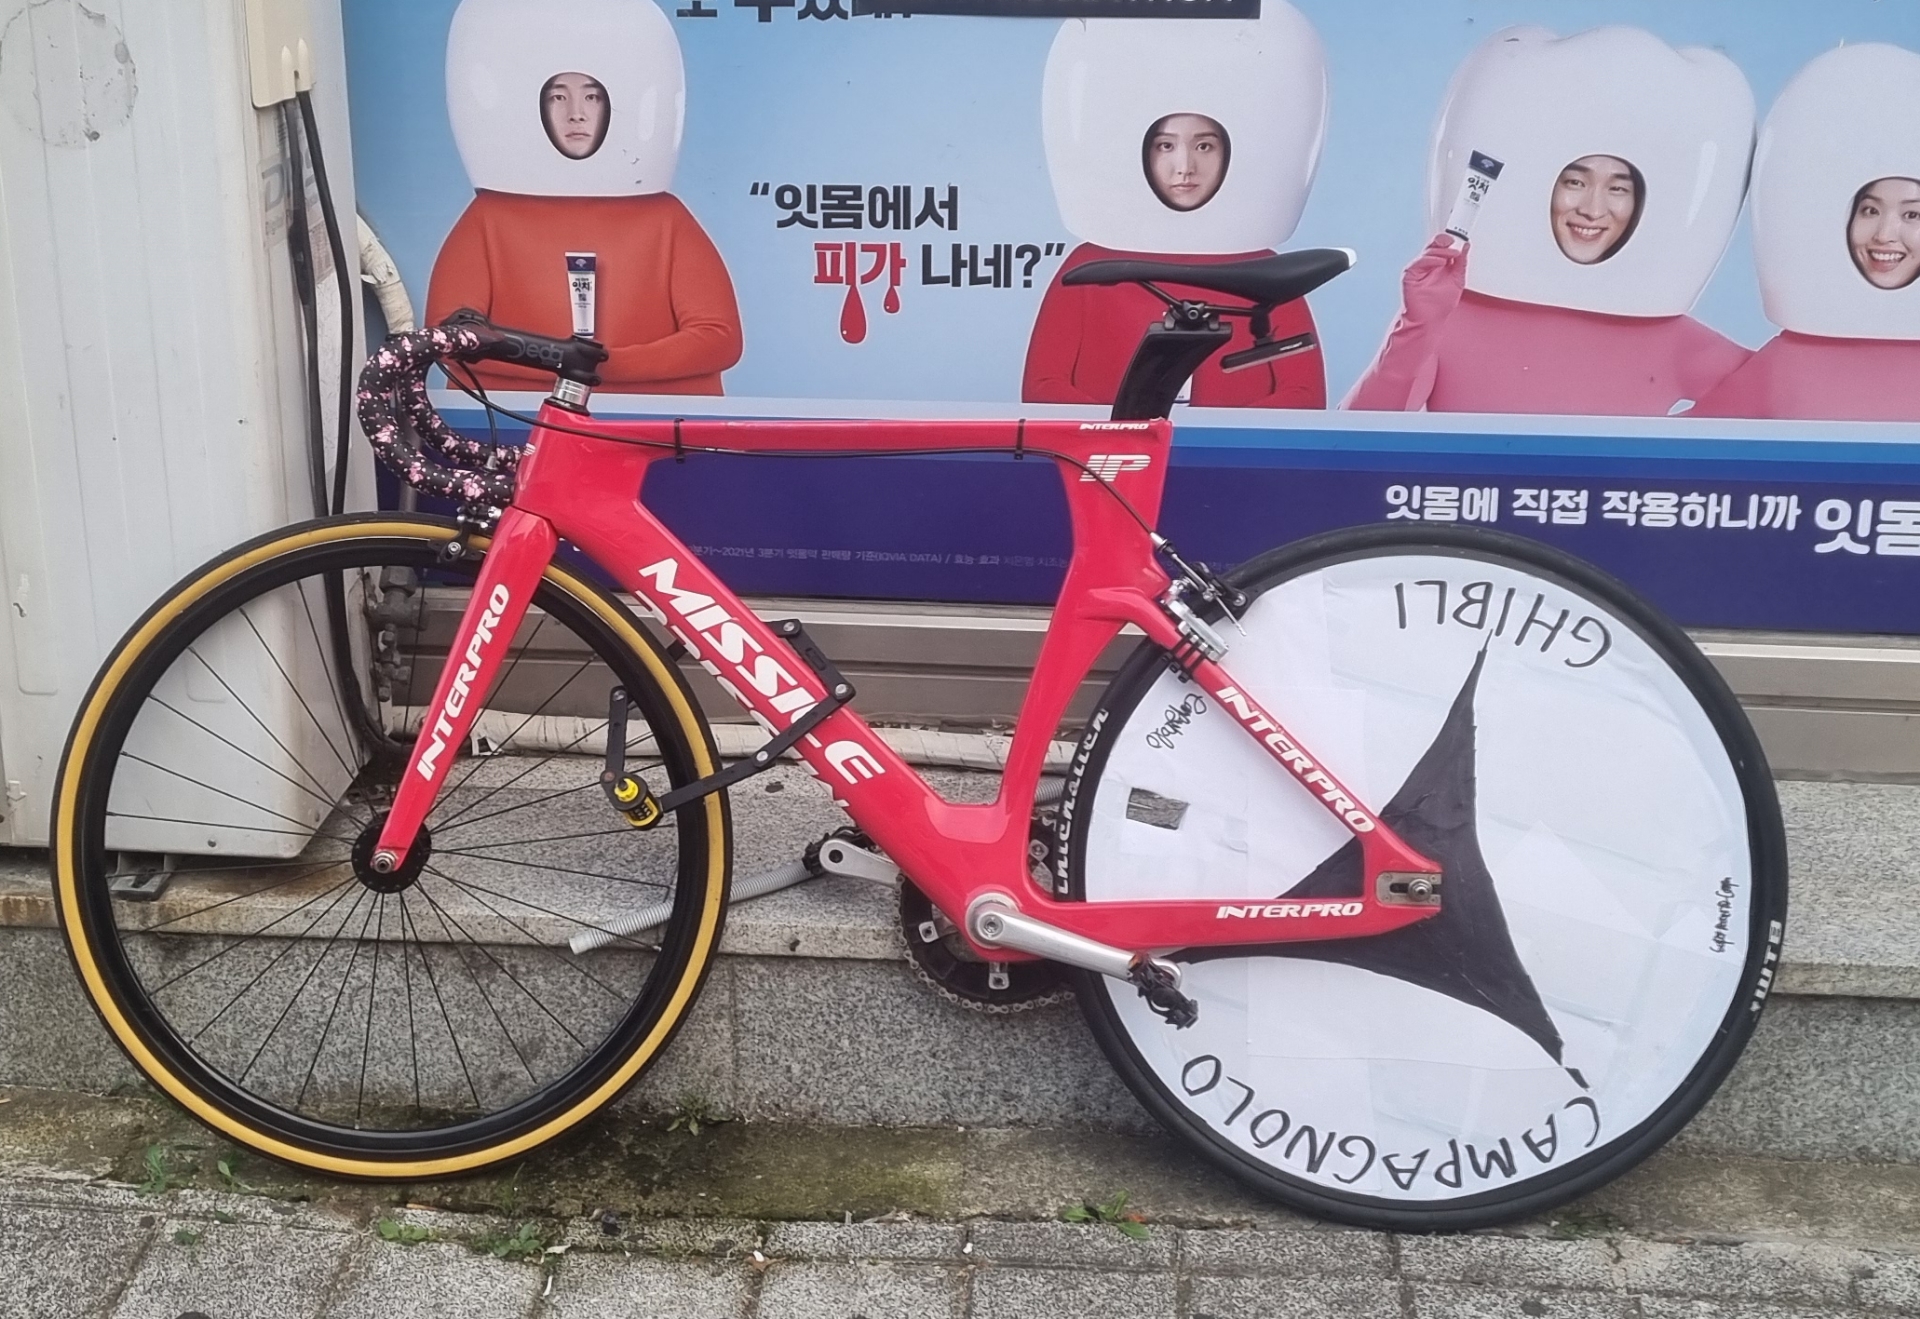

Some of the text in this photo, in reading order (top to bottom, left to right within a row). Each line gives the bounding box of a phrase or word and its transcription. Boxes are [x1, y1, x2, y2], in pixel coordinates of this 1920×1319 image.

[749, 182, 958, 231] “잇몸에서
[813, 241, 1066, 289] 피가 나네?”
[1079, 422, 1150, 431] INTERPRO
[1385, 484, 1500, 524] 잇몸에
[1512, 486, 1590, 525] 직접
[1601, 490, 1802, 532] 작용하니까
[1394, 580, 1612, 668] GHIBLI
[416, 583, 510, 782] INTERPRO
[1216, 685, 1376, 833] INTERPRO
[1215, 902, 1364, 919] INTERPRO
[1181, 1053, 1601, 1190] CAMPAGNOLO
